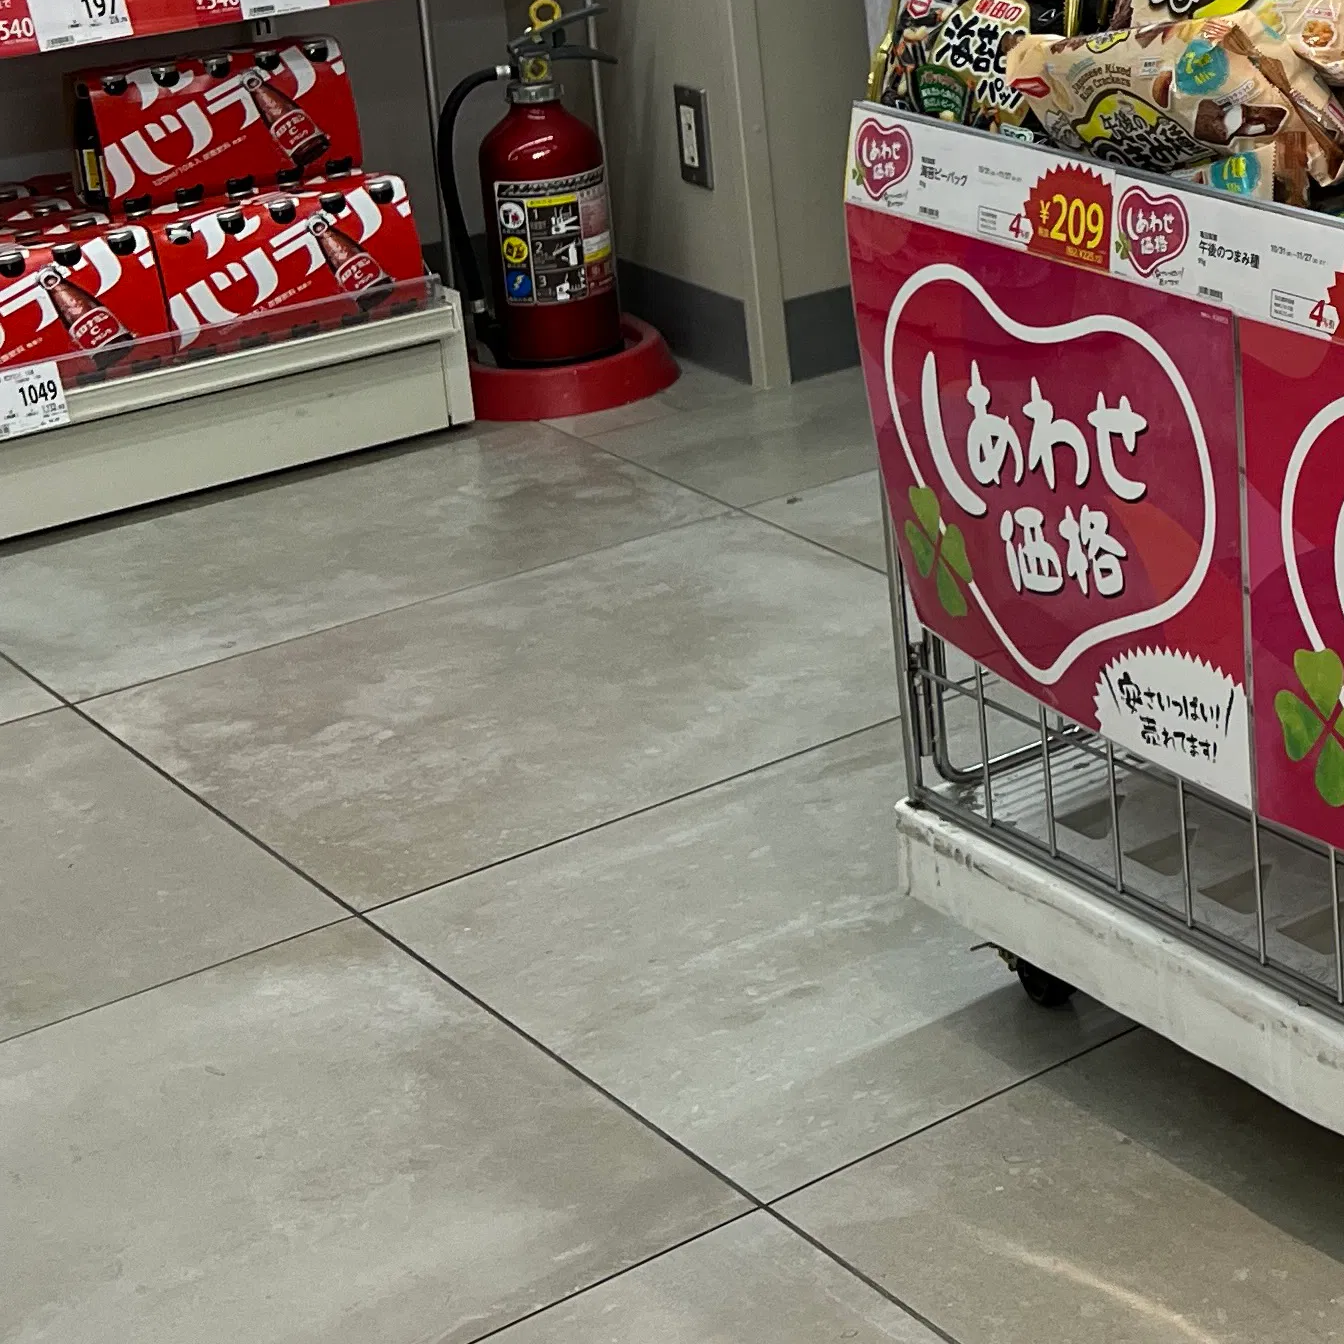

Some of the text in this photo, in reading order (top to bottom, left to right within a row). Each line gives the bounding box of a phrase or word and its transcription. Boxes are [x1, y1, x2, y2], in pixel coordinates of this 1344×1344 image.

[1040, 193, 1104, 250] ¥209
[1126, 207, 1175, 241] しあわせ
[18, 381, 58, 407] 1049
[920, 349, 1148, 516] しあわせ
[1000, 503, 1127, 597] 価格
[1117, 669, 1220, 730] 安さいっぱい!
[1139, 714, 1217, 763] 売れてます!
